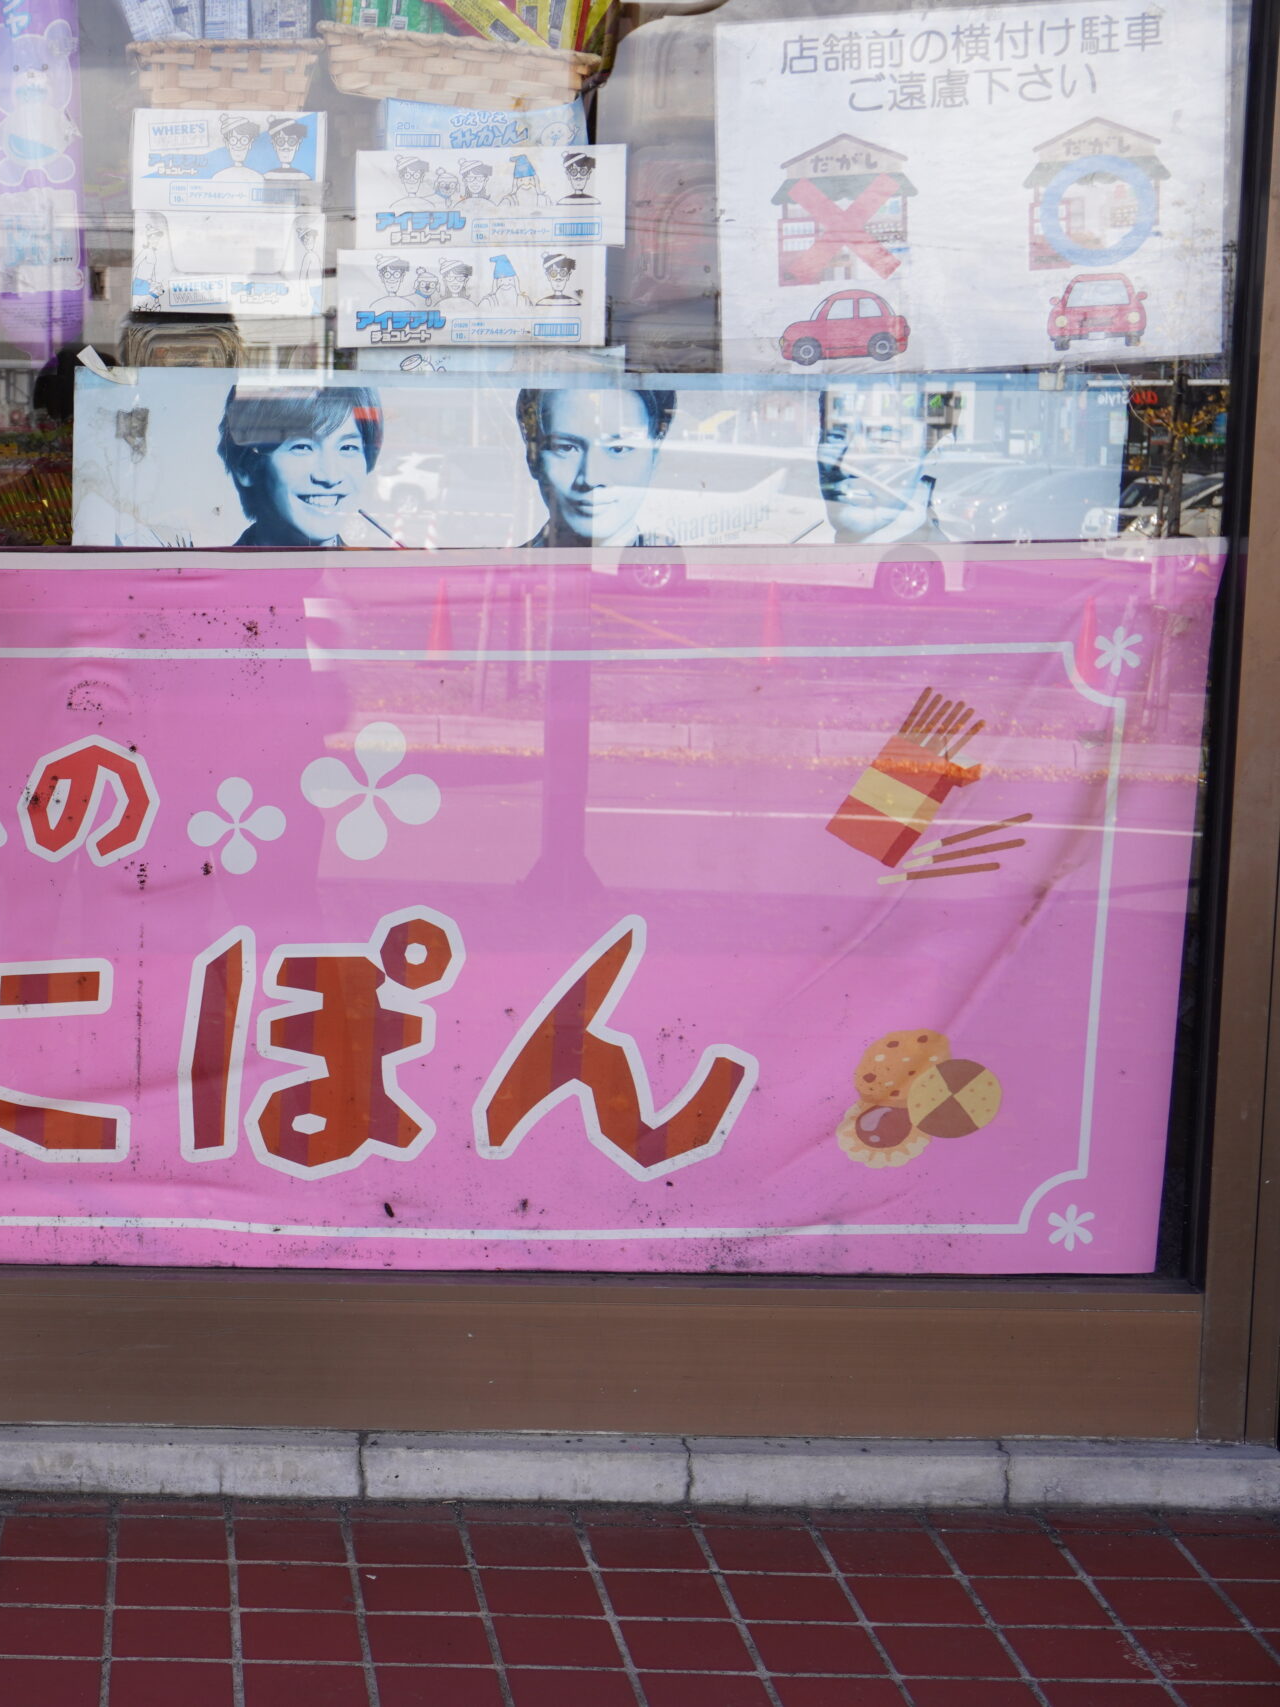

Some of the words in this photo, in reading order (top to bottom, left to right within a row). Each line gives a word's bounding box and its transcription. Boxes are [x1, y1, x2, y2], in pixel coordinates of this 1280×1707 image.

[780, 13, 1164, 76] 店舗前の横付け駐車
[847, 61, 1098, 113] ご遠慮下さい
[151, 123, 206, 137] WHERE'S
[1061, 136, 1132, 156] だがし
[809, 152, 879, 173] だがし
[375, 211, 467, 233] アイデアル
[389, 229, 452, 246] チョコレート
[356, 310, 447, 331] アイデアル
[370, 329, 432, 344] チョコレート
